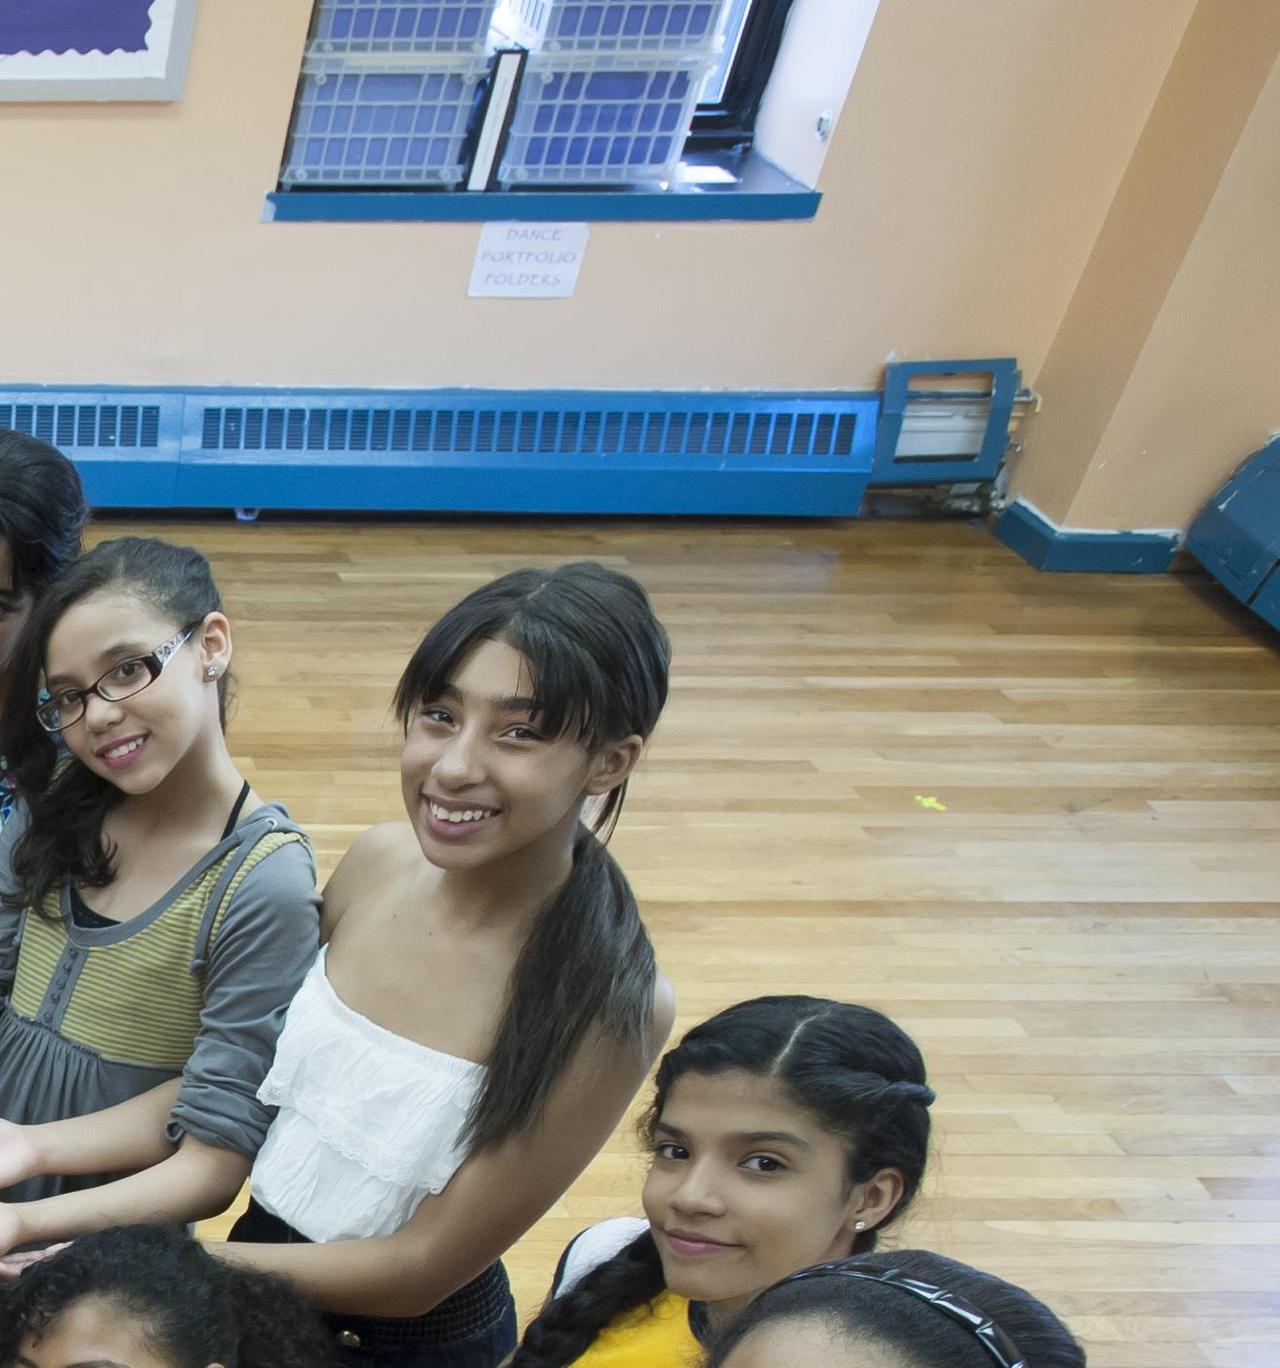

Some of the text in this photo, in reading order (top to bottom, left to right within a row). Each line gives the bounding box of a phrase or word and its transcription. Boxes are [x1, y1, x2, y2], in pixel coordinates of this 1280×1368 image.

[506, 228, 561, 241] DANCE
[480, 250, 577, 263] PORTFOLIO
[484, 273, 561, 286] FOLDERS
